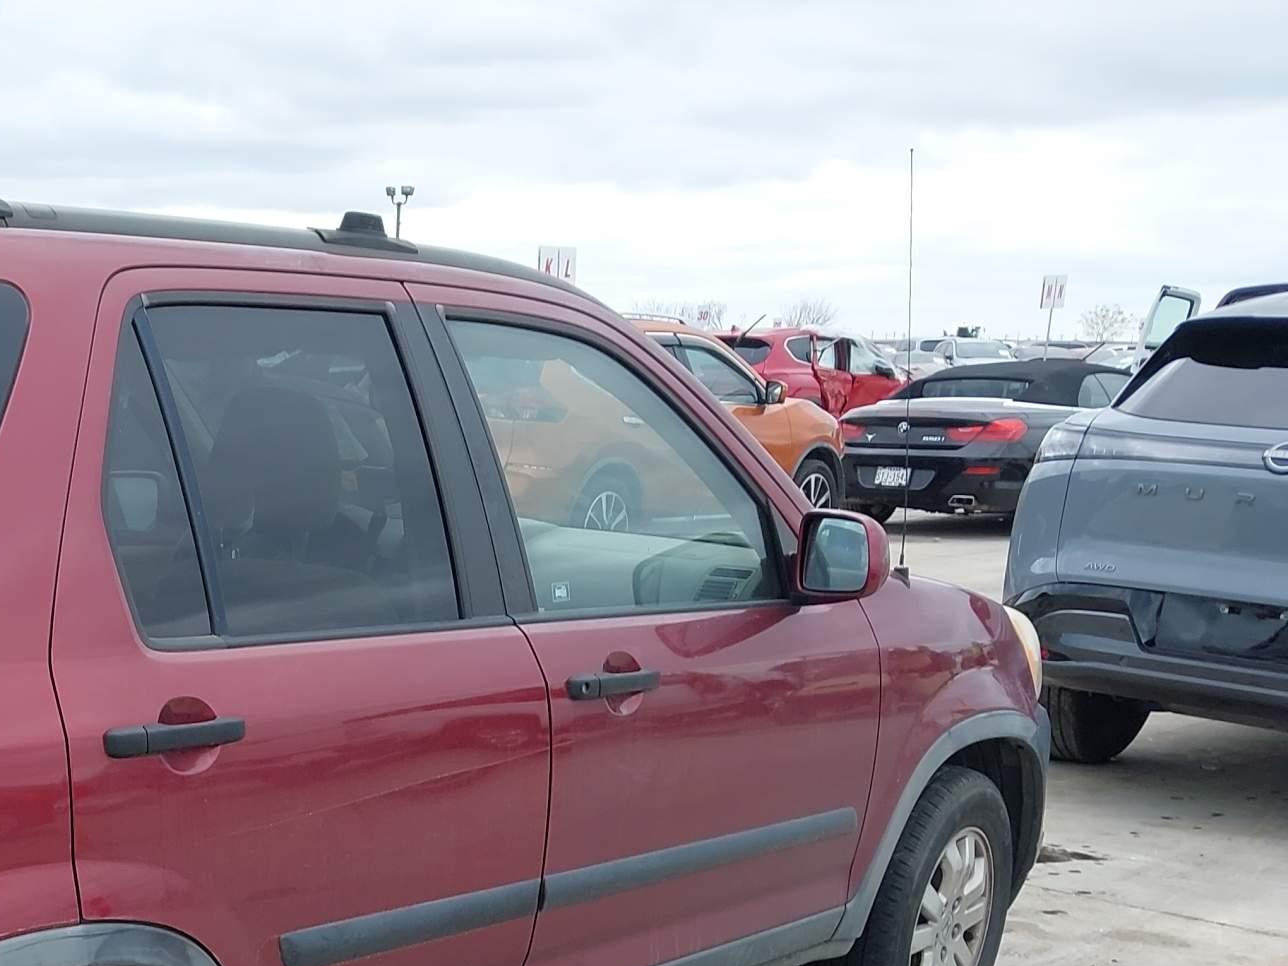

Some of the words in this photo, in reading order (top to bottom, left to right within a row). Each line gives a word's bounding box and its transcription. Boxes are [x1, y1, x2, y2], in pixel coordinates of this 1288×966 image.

[545, 257, 553, 275] K
[565, 258, 571, 278] L
[1083, 561, 1117, 574] AWD
